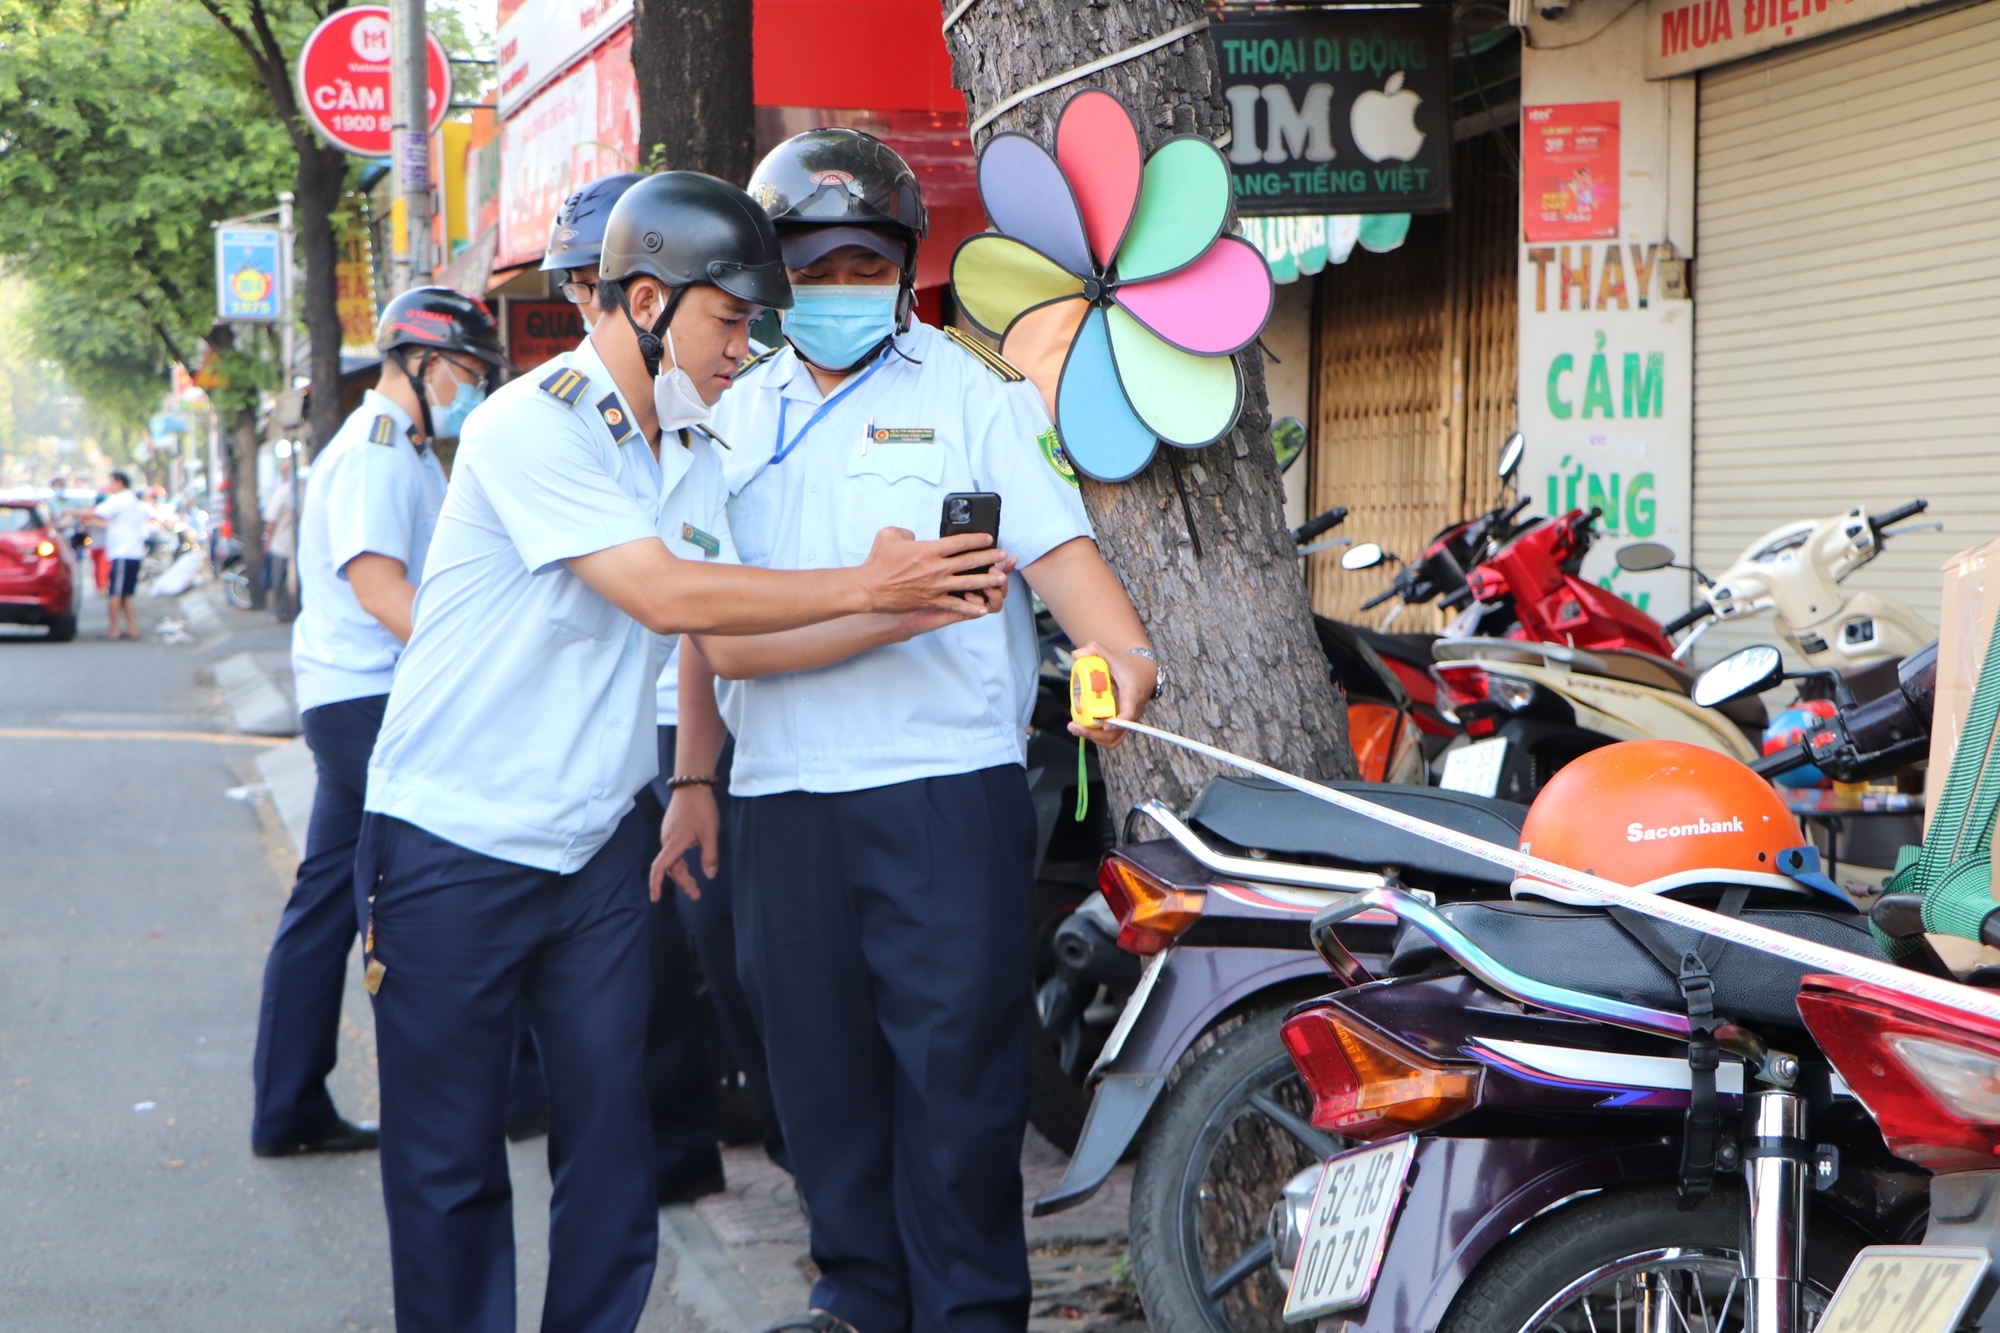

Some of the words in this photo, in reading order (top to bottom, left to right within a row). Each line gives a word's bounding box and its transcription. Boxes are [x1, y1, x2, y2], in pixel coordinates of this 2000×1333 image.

[1222, 37, 1306, 80] THOẠI
[1313, 38, 1341, 73] DI
[1348, 30, 1428, 79] ĐỘNG
[1661, 0, 1733, 57] MUA
[314, 77, 385, 111] CẦM
[332, 114, 377, 132] 1900
[1224, 82, 1337, 165] IM
[1374, 163, 1430, 196] VIỆT
[1528, 244, 1658, 314] THAY
[526, 310, 584, 339] QUA
[1546, 328, 1665, 420] CẢM
[1626, 815, 1744, 843] Sacombank
[1319, 1151, 1395, 1228] 52-H3
[1301, 1226, 1370, 1302] 0079
